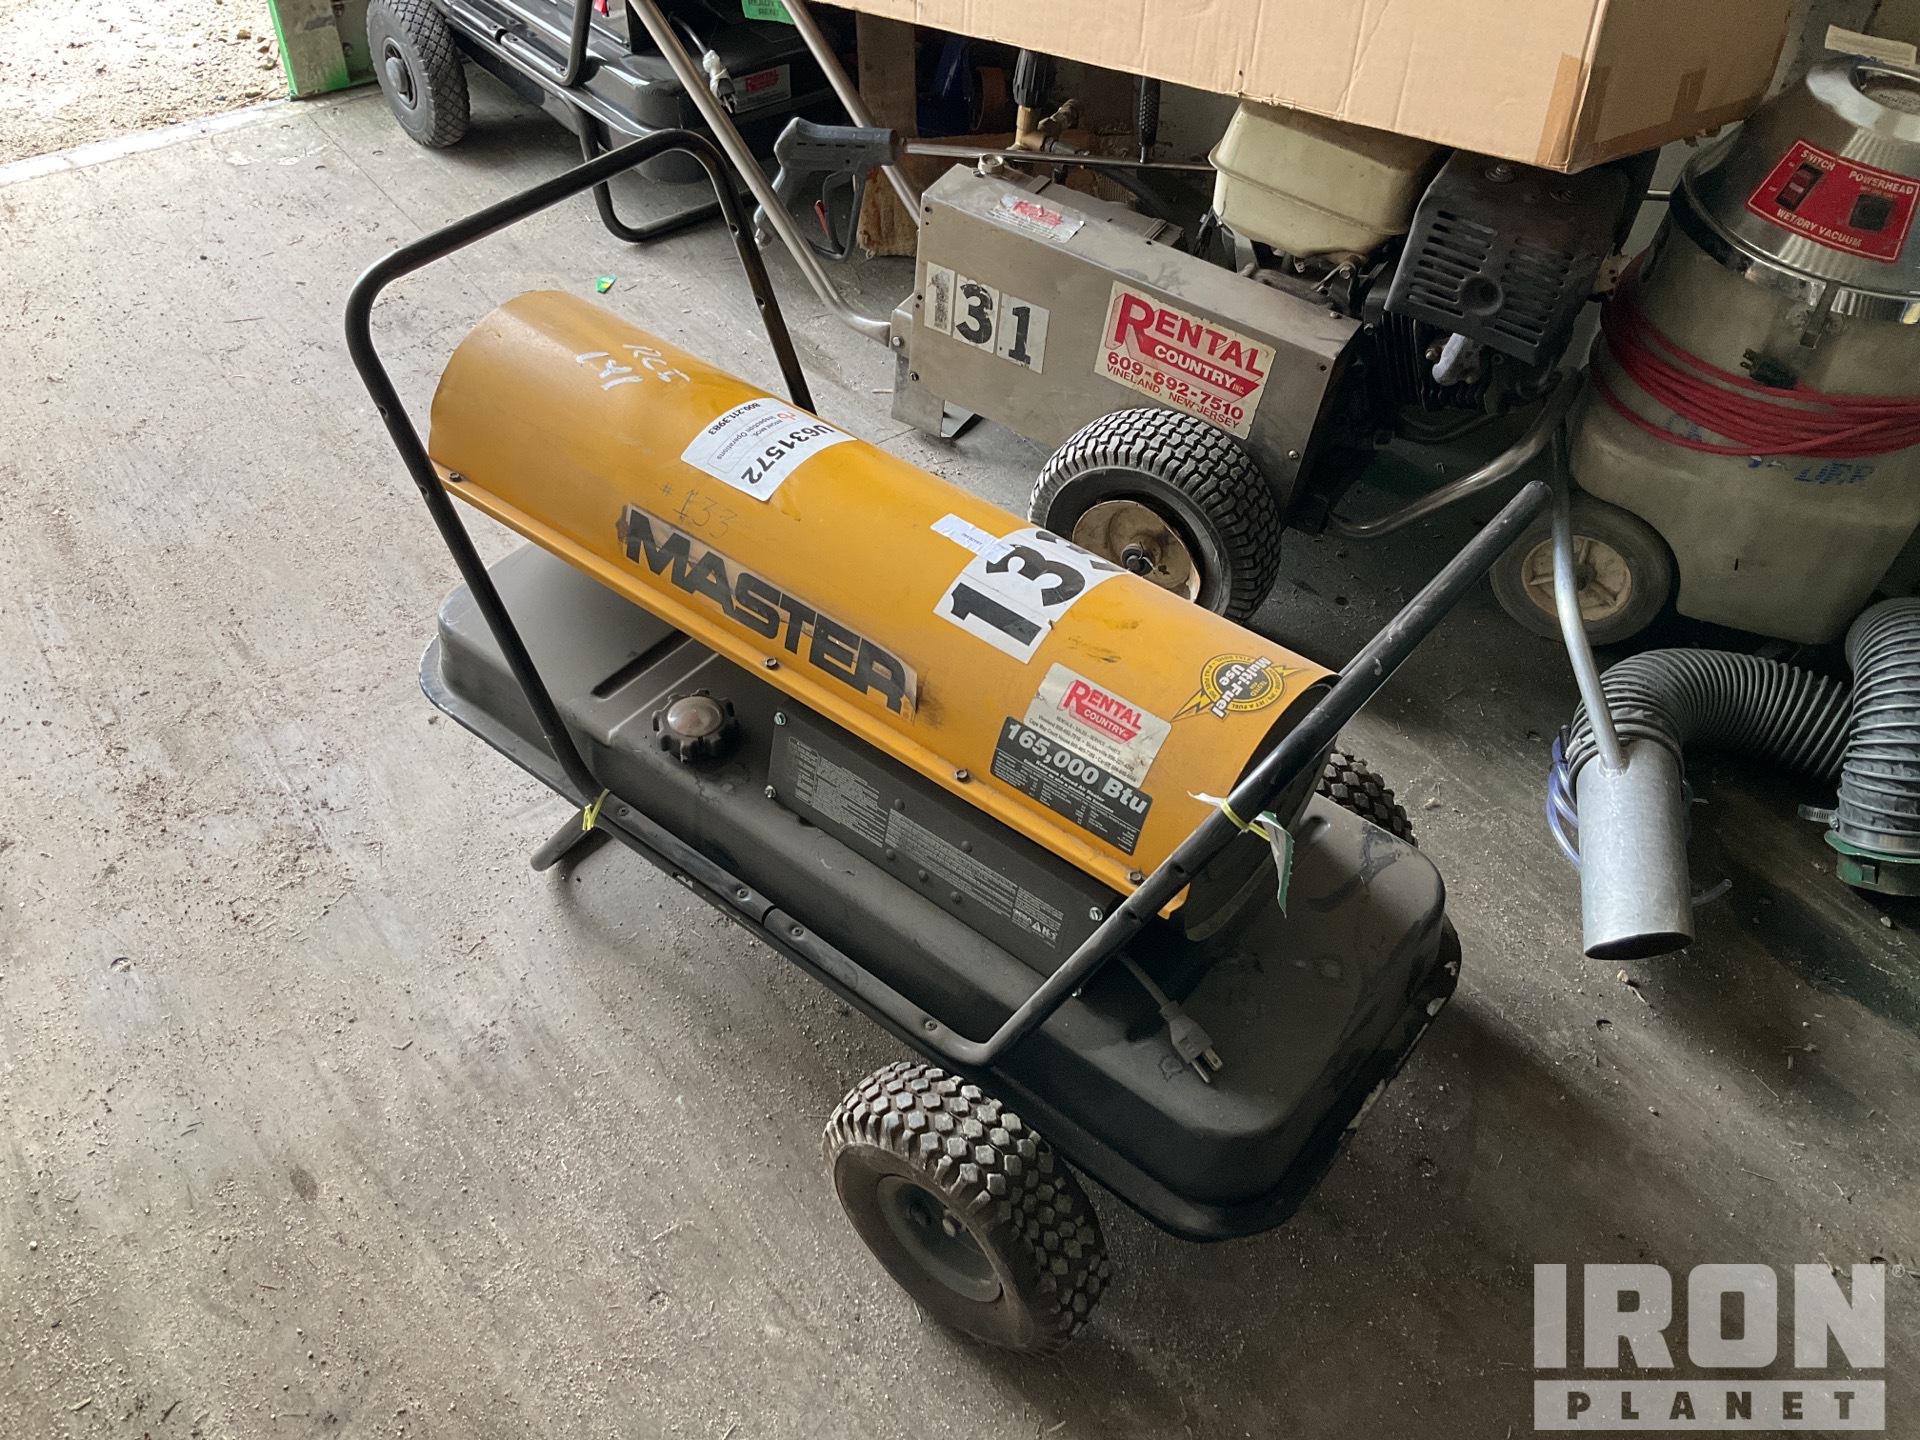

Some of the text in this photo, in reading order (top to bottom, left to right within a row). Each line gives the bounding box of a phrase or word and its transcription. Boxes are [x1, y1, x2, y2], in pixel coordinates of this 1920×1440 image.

[1800, 150, 1836, 171] SWITCH
[1848, 171, 1914, 195] POWERHEAD
[1776, 208, 1863, 247] WET/DRY VACUUM
[928, 271, 1032, 365] 131
[1112, 293, 1265, 379] RENTAL
[1107, 351, 1244, 421] 609-692-7510
[1154, 345, 1236, 390] COUNTRY
[708, 402, 761, 436] 800.211.3983
[1106, 363, 1240, 429] VINELAND, NEW JERSEY
[716, 431, 748, 460] Operations
[740, 424, 836, 485] U631572
[626, 508, 907, 716] MASTER
[1211, 656, 1272, 718] Multi-Fuel
[1219, 664, 1246, 686] Use
[1063, 679, 1143, 731] RENTAL
[1084, 709, 1124, 737] COUNTRY
[1010, 723, 1099, 785] 165,000
[1102, 777, 1148, 814] Btu
